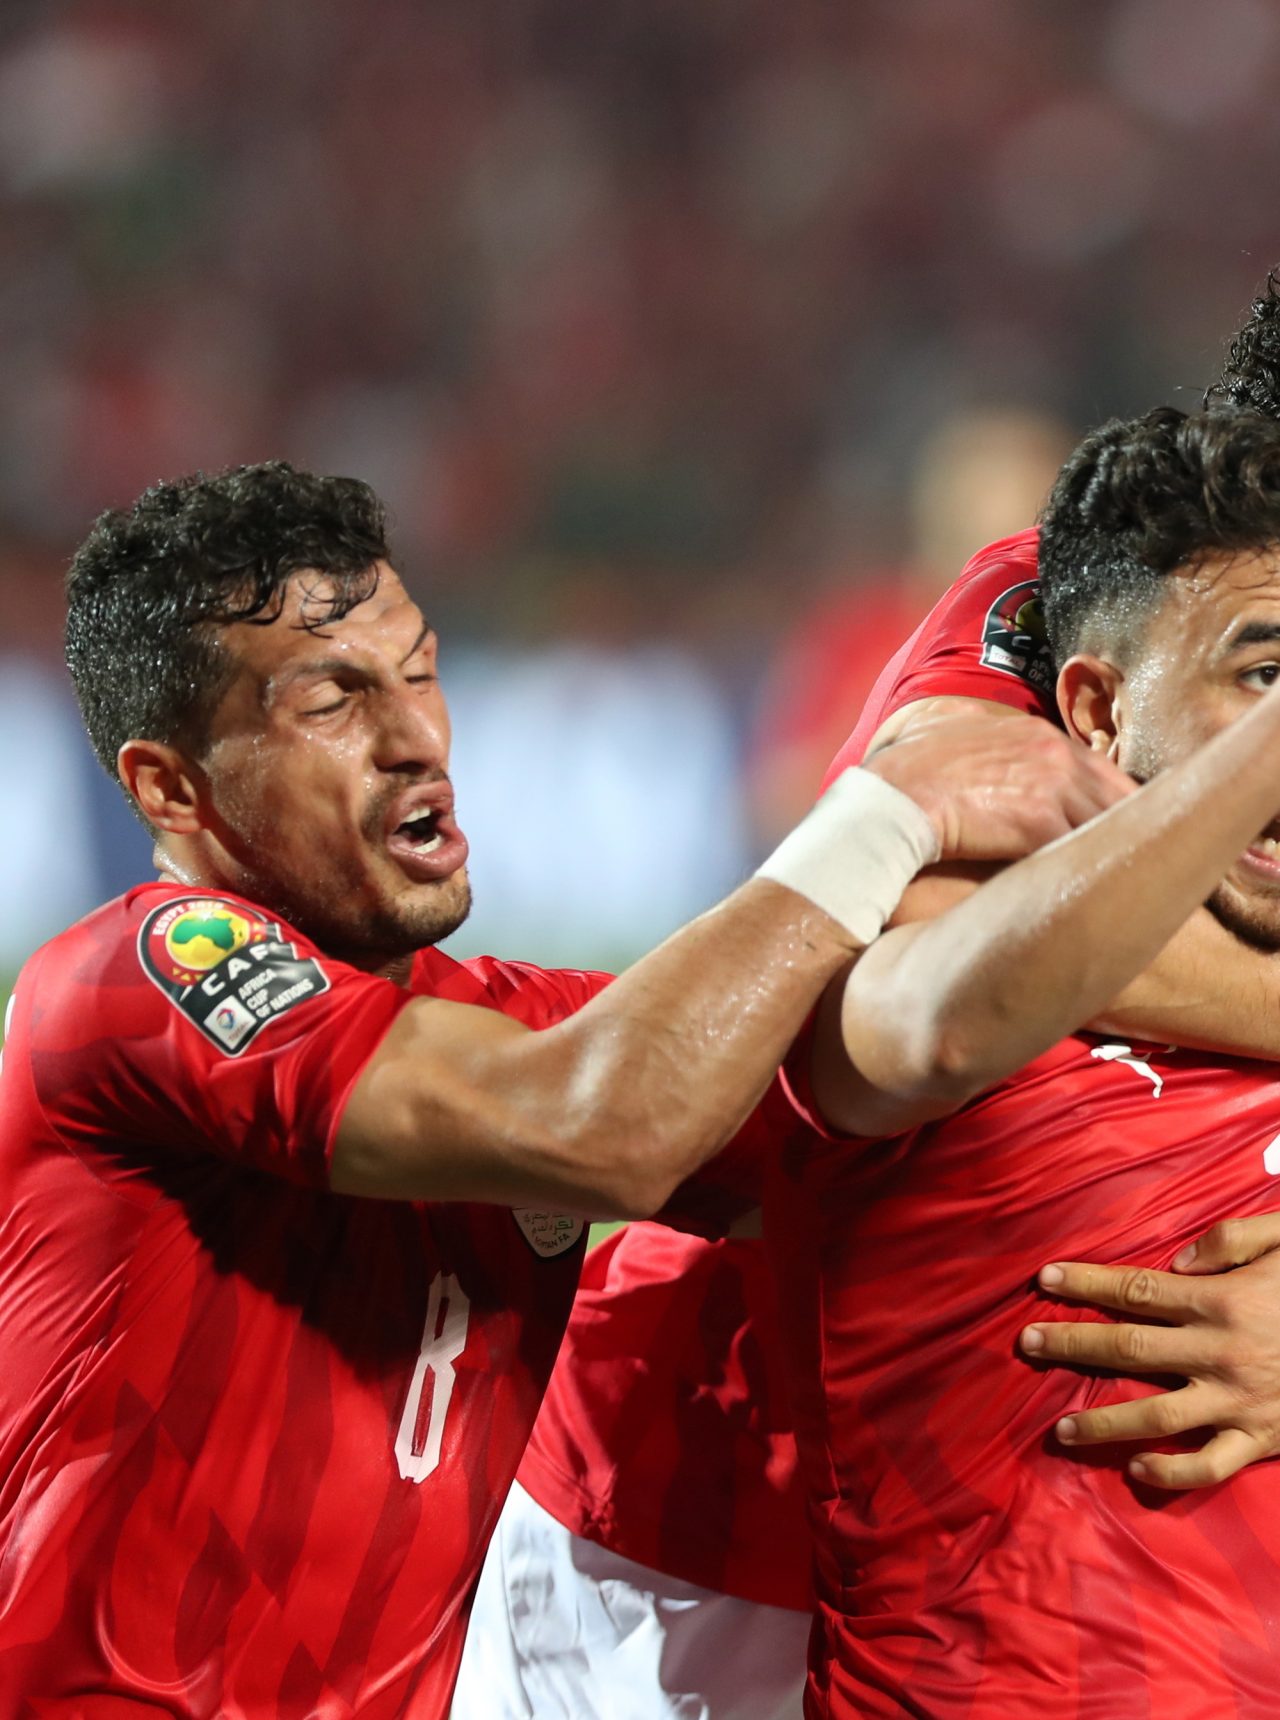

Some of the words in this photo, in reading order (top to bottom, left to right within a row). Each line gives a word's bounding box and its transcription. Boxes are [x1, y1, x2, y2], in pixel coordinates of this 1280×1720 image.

[152, 904, 185, 935] EGYPT
[201, 944, 269, 996] CAF
[238, 968, 277, 1000] AFRICA
[246, 988, 269, 1010] CUP
[255, 1003, 271, 1018] OF
[269, 978, 314, 1010] NATIONS
[394, 1270, 471, 1484] 8
